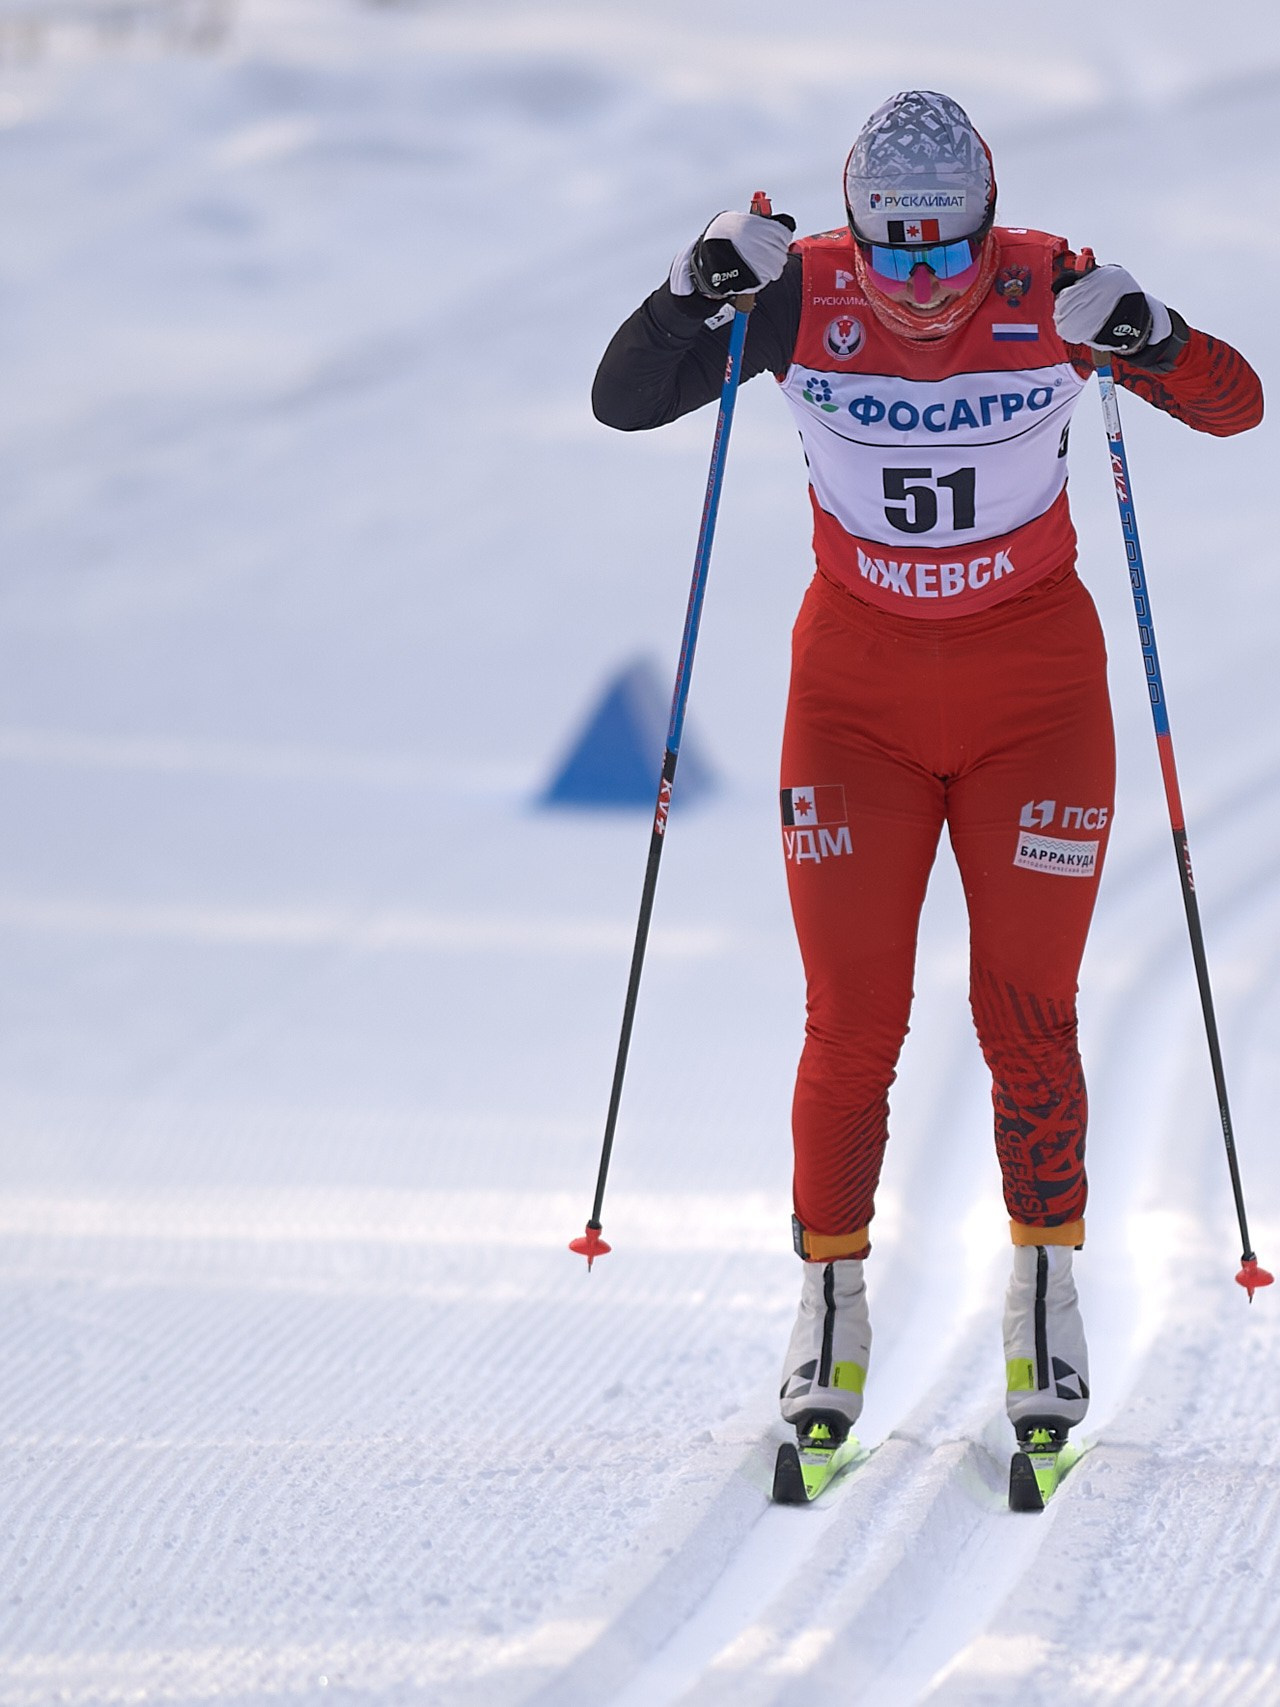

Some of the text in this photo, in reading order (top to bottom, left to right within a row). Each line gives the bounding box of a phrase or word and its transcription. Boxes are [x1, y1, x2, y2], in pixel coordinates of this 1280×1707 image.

[884, 195, 965, 207] РУСКЛИМАТ
[848, 386, 1054, 432] ФОСАГРО
[882, 467, 976, 534] 51
[857, 546, 1016, 598] ИЖЕВСК
[1061, 806, 1108, 830] ПСБ
[783, 826, 853, 865] УДМ
[1020, 845, 1094, 868] БАРРАКУДА
